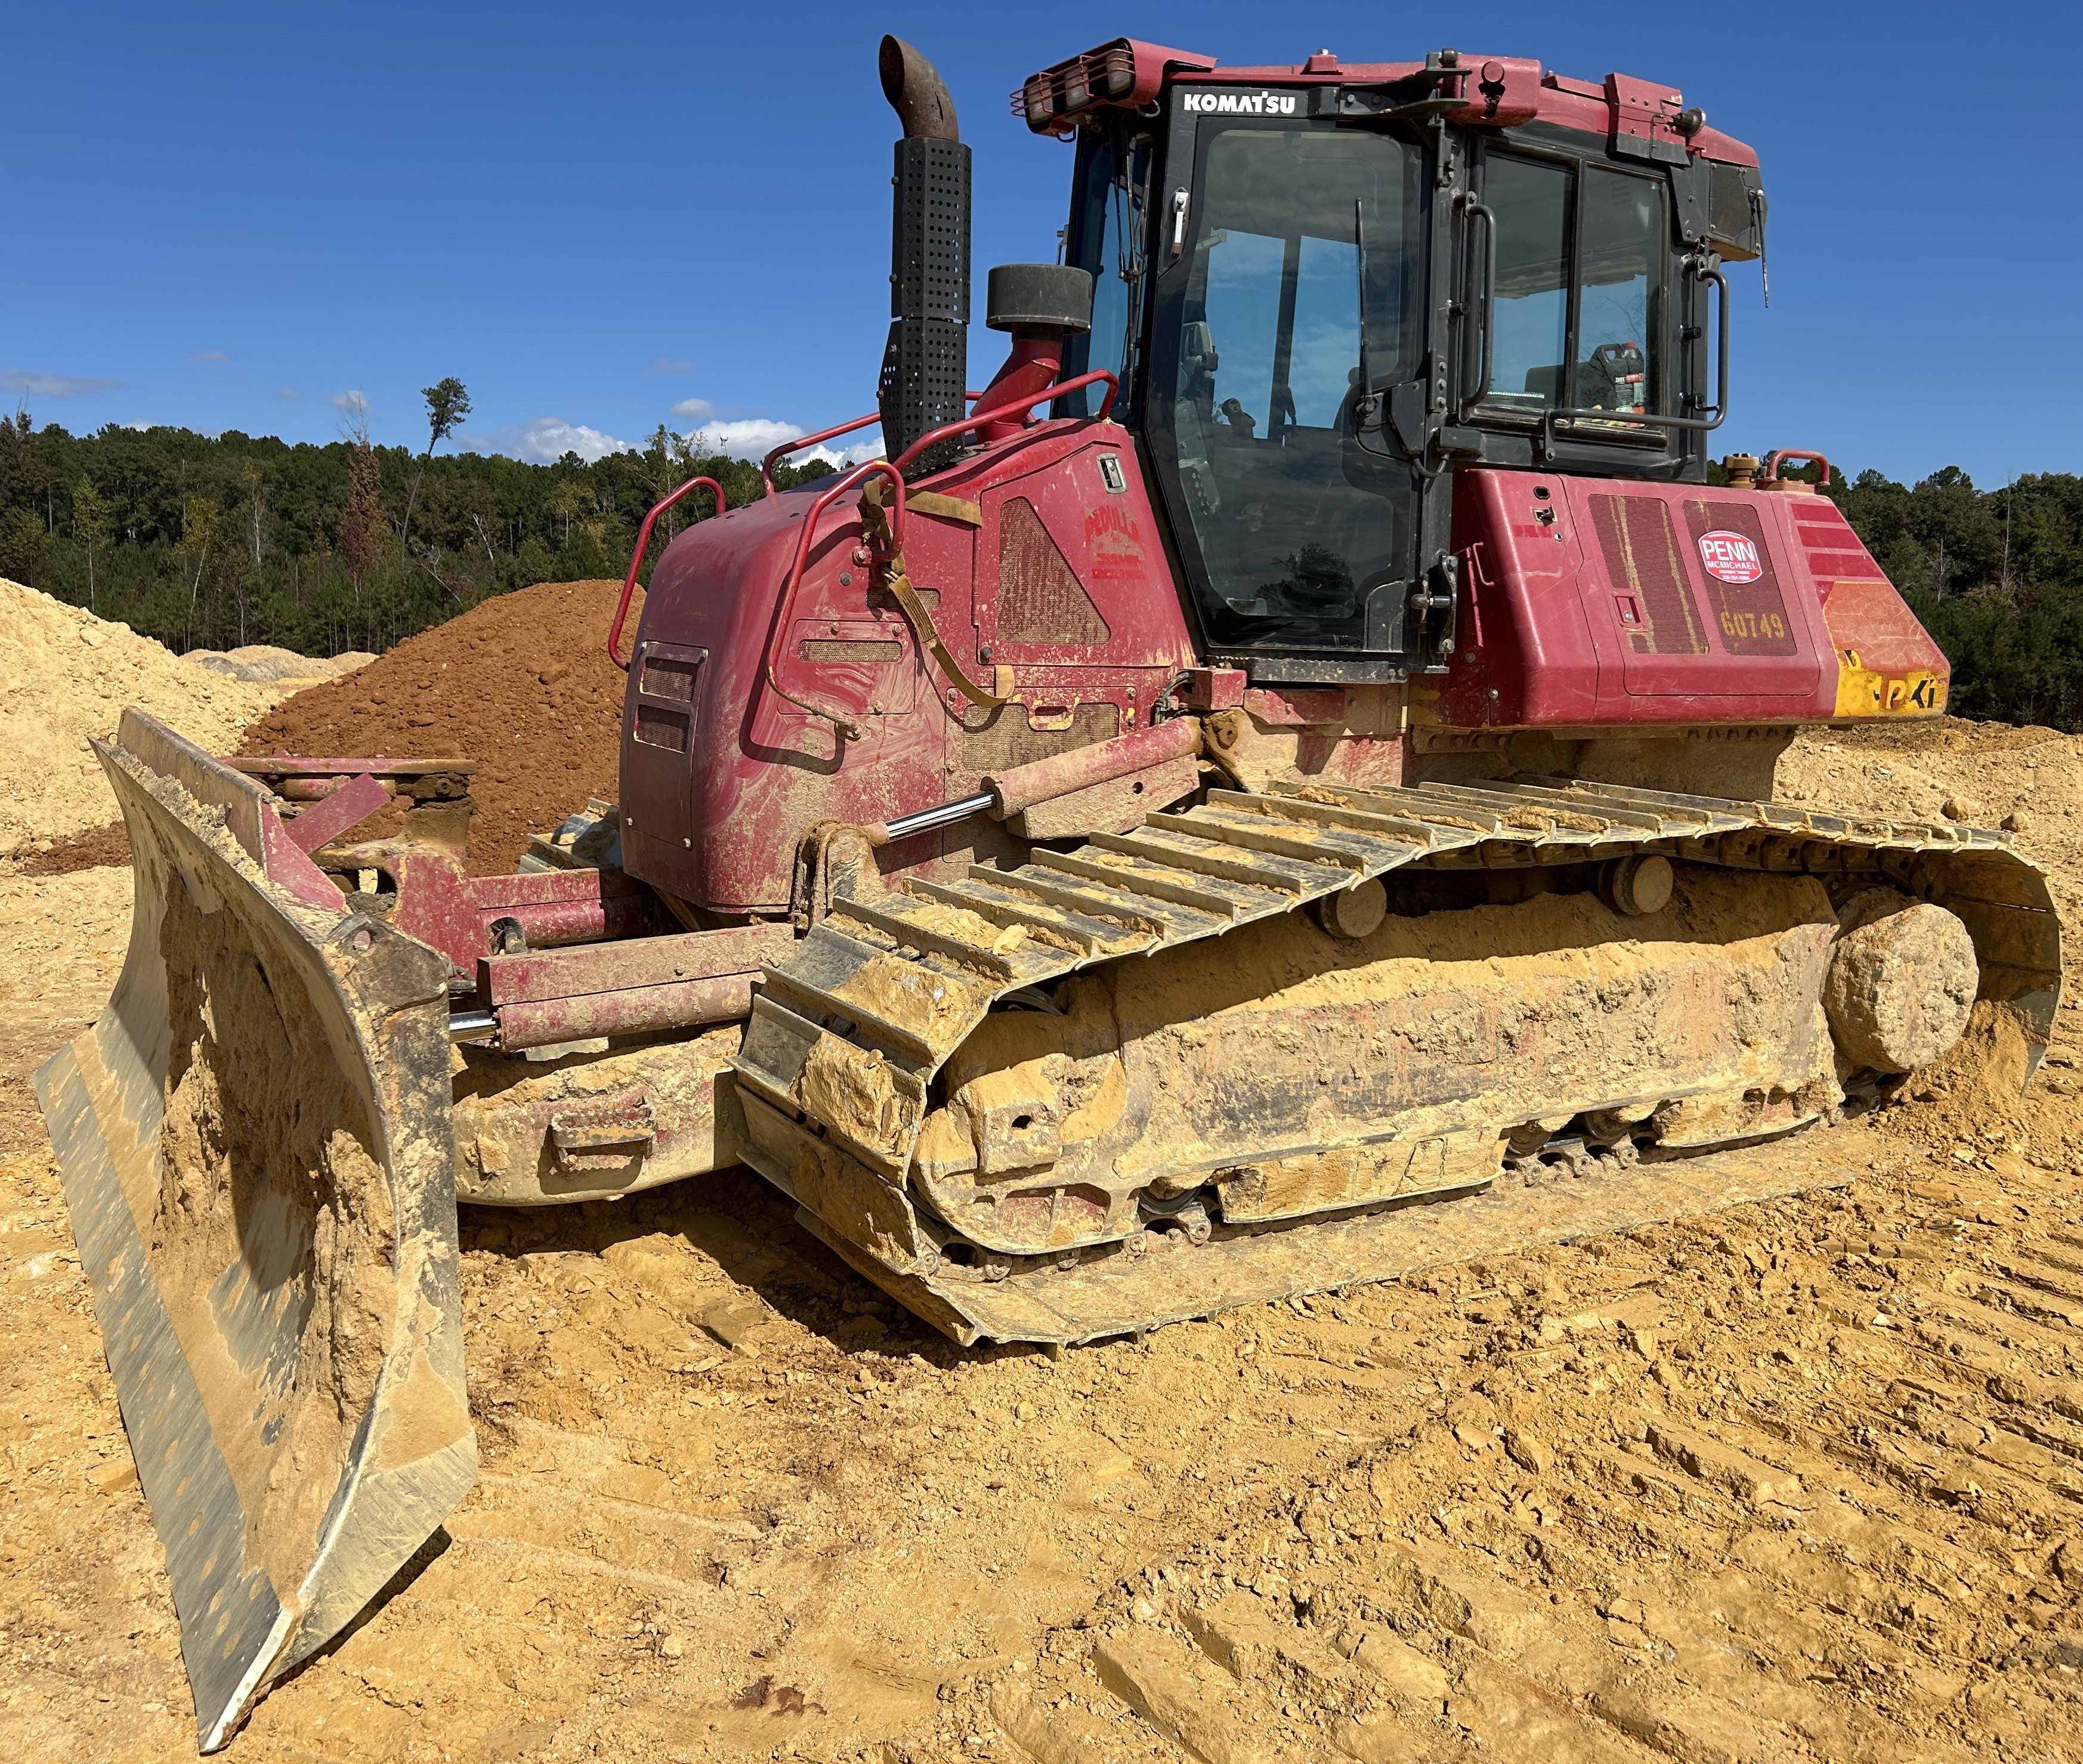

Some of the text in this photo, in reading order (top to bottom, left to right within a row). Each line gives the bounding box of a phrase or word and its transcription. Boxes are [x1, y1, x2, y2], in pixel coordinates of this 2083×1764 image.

[1183, 91, 1295, 113] KOMATSU
[1701, 539, 1756, 561] PENN
[1707, 560, 1758, 570] MCMICHAEL
[1720, 611, 1785, 638] 60749
